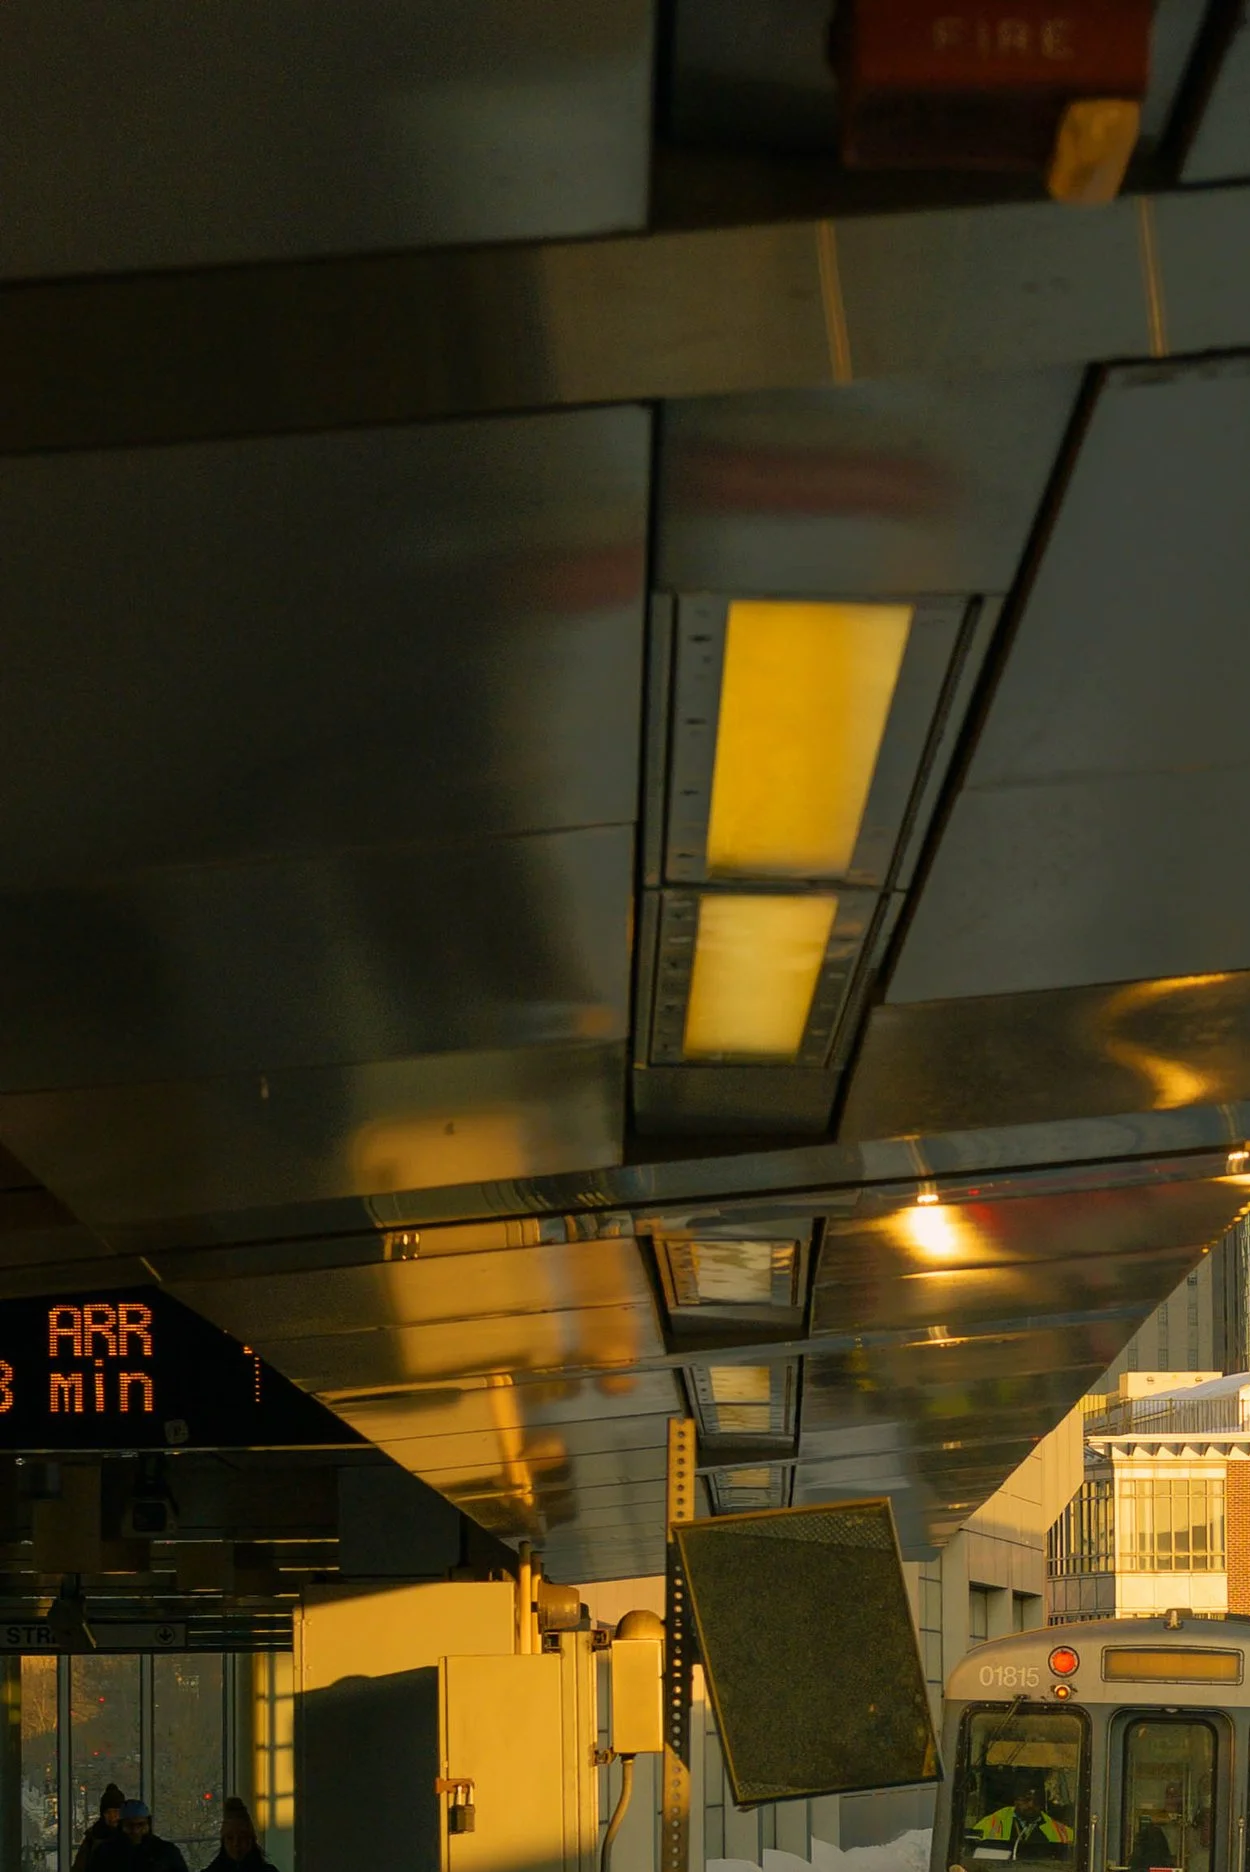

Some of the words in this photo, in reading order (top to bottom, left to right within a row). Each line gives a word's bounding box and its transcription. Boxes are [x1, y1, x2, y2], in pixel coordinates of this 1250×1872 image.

[932, 16, 1075, 60] FIRE
[47, 1303, 154, 1358] ARR
[47, 1358, 155, 1414] min
[978, 1665, 1040, 1688] 01815
